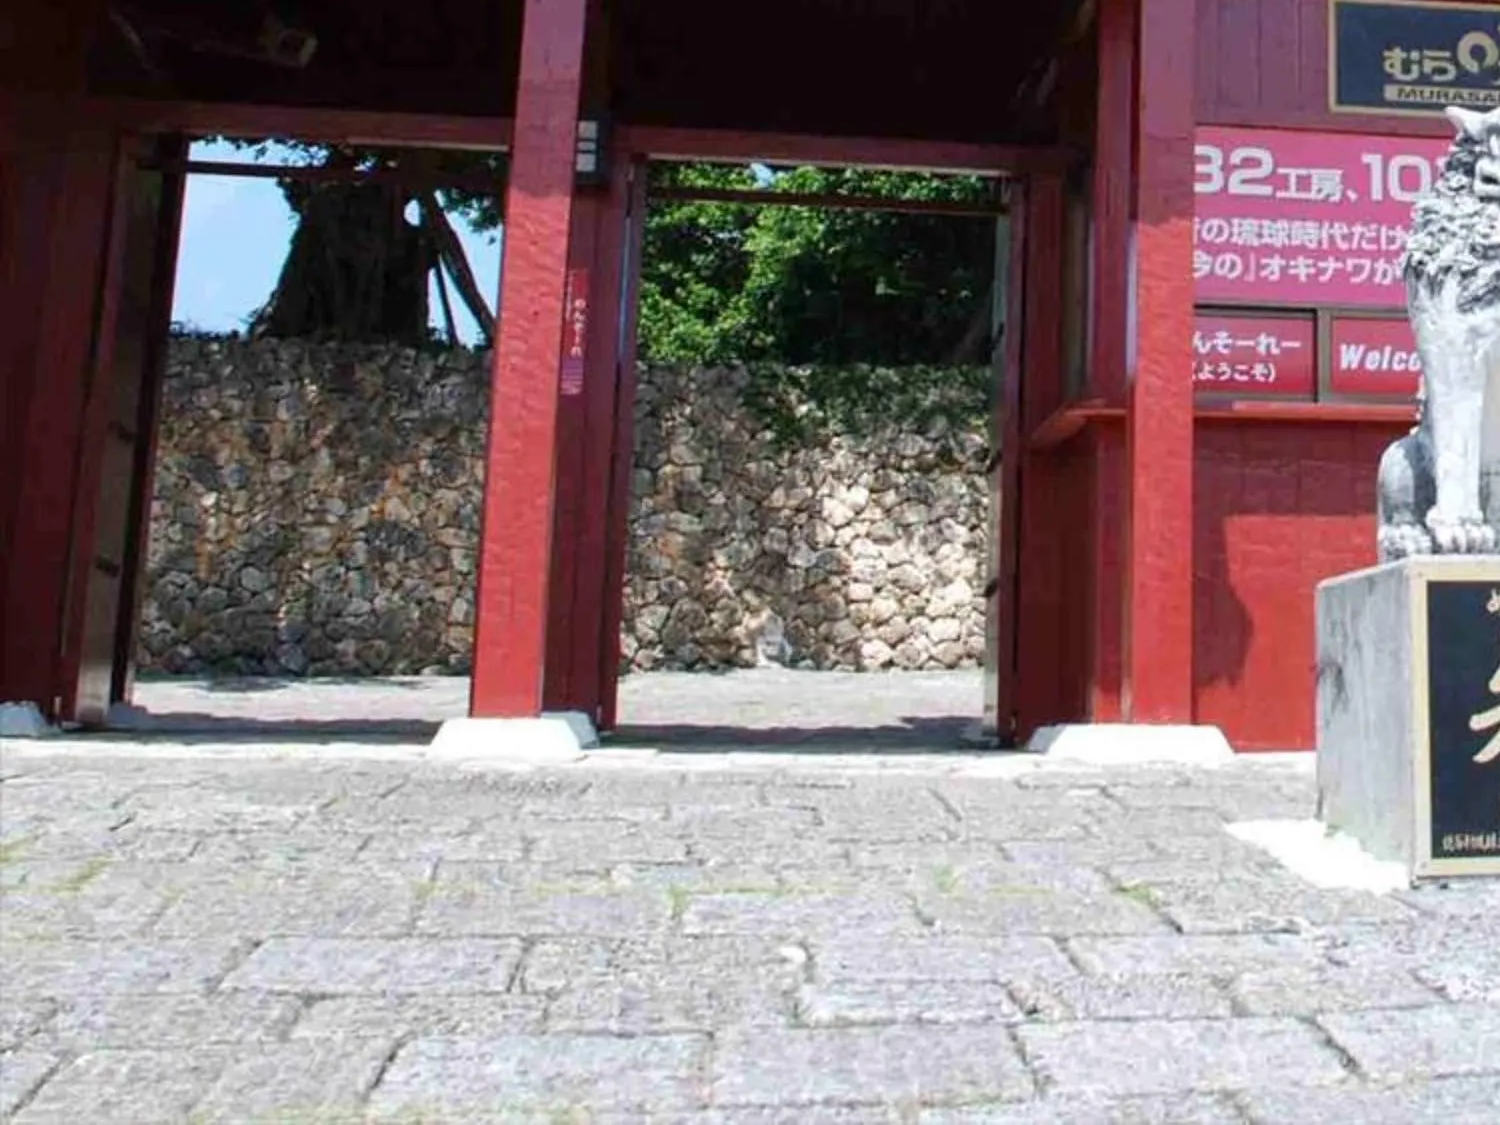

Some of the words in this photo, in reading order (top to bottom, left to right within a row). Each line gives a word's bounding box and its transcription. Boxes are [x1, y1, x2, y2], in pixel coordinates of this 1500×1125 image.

[1193, 216, 1411, 252] の琉球時代だけ
[1338, 343, 1422, 372] Welco
